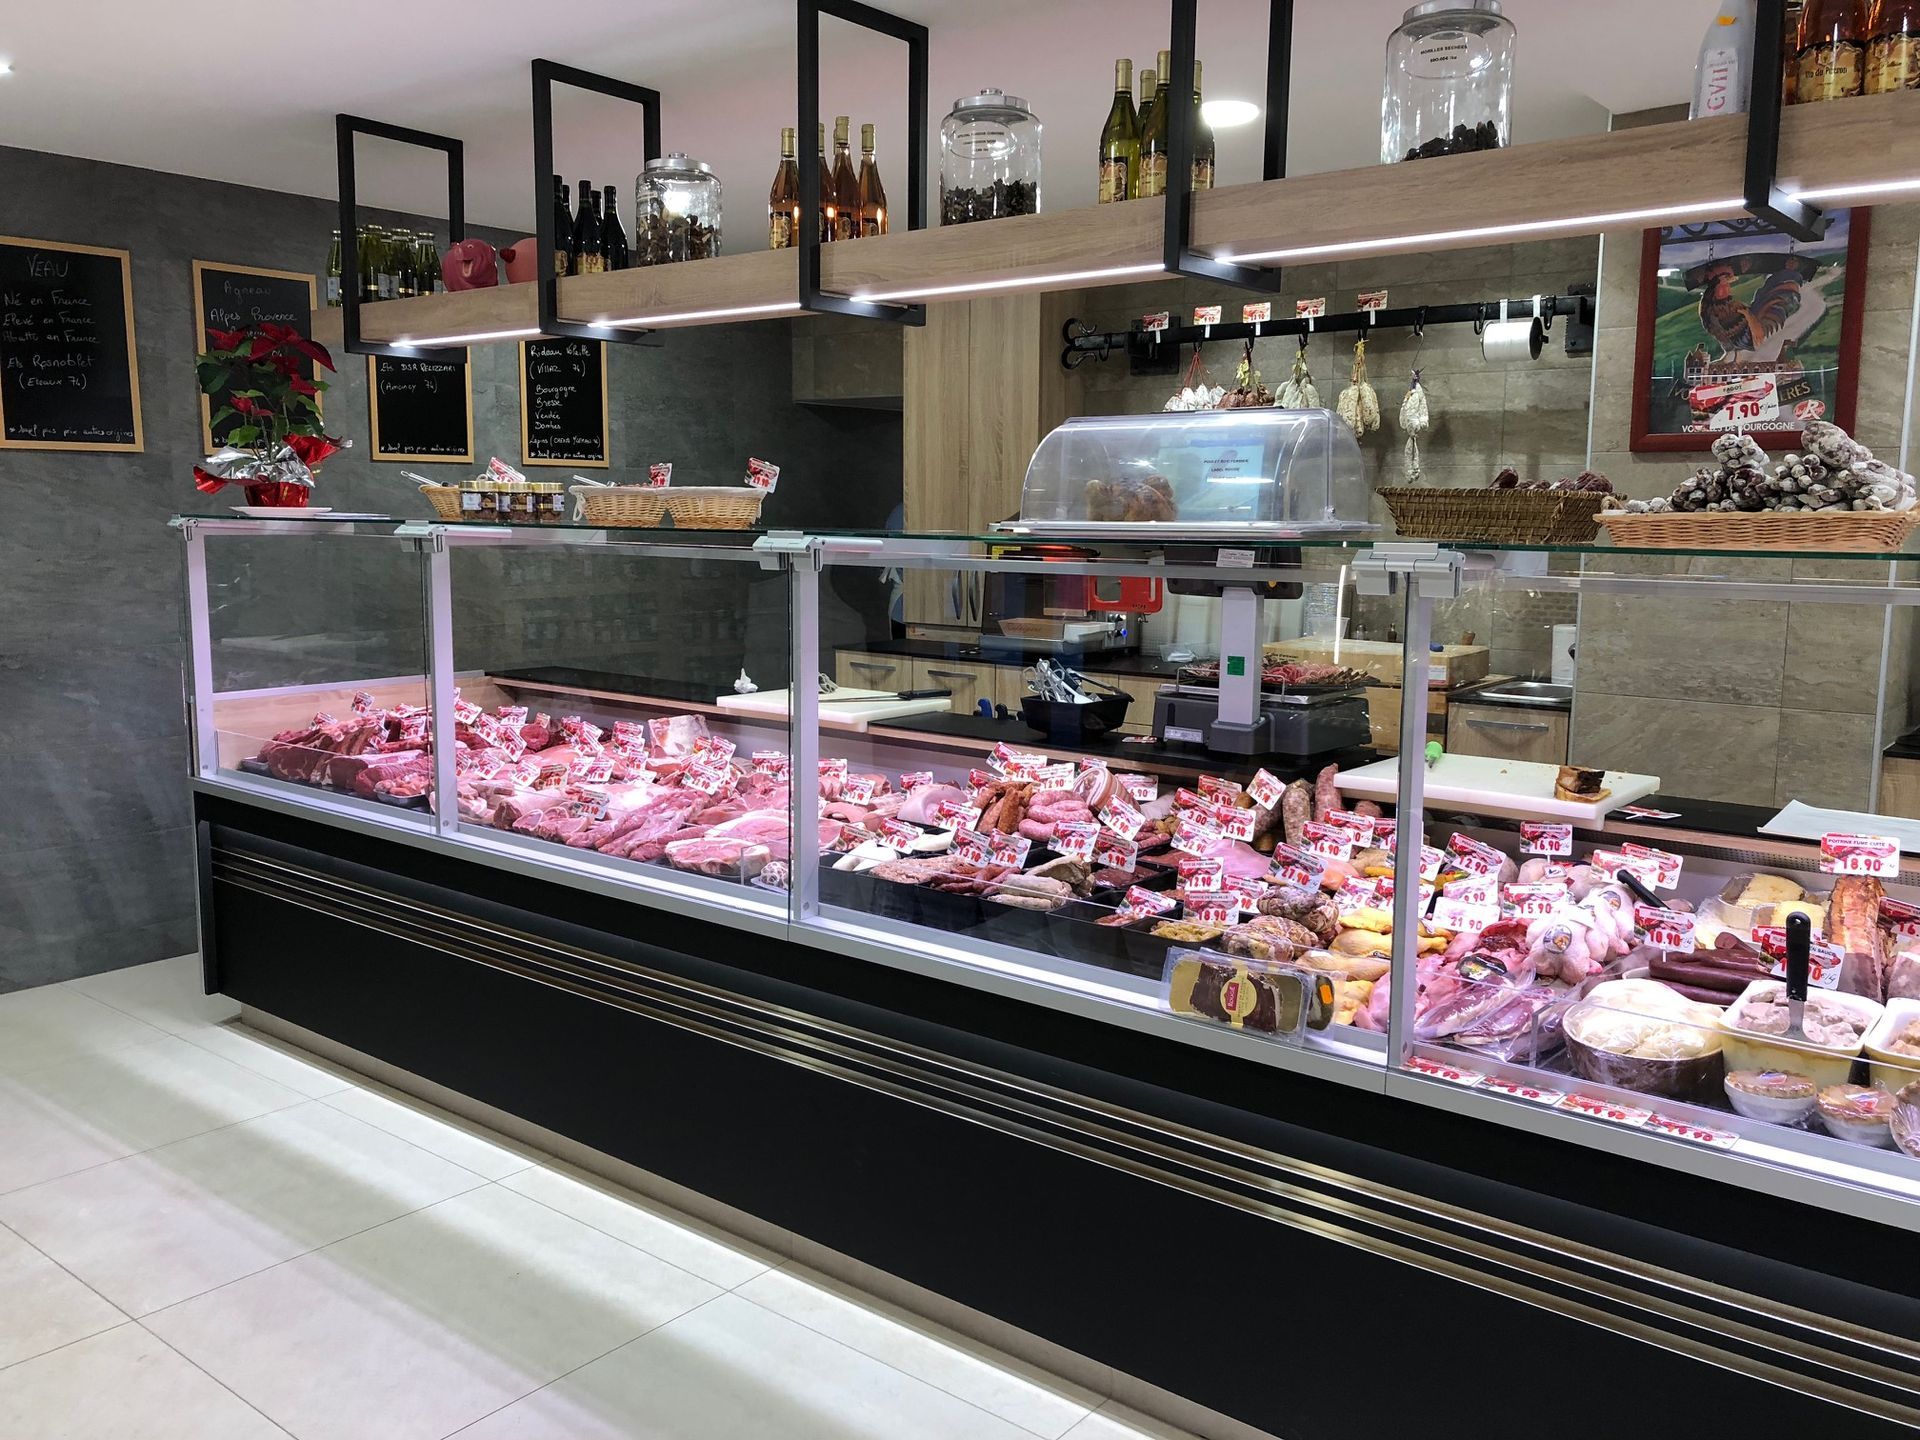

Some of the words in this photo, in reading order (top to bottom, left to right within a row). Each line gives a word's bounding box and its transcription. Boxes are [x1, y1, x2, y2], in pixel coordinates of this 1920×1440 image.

[27, 254, 69, 277] VEAU
[4, 293, 21, 306] Né
[51, 289, 92, 306] France
[224, 280, 272, 304] Agneau
[58, 311, 96, 324] France
[210, 308, 241, 327] Alpes
[250, 306, 298, 321] Provence
[46, 334, 60, 342] en
[63, 329, 99, 344] France
[535, 384, 577, 400] Bourgogne
[1459, 855, 1488, 875] 12.90
[1841, 858, 1882, 872] 18.90
[1281, 865, 1310, 886] 27.90
[1648, 928, 1682, 947] 10.90
